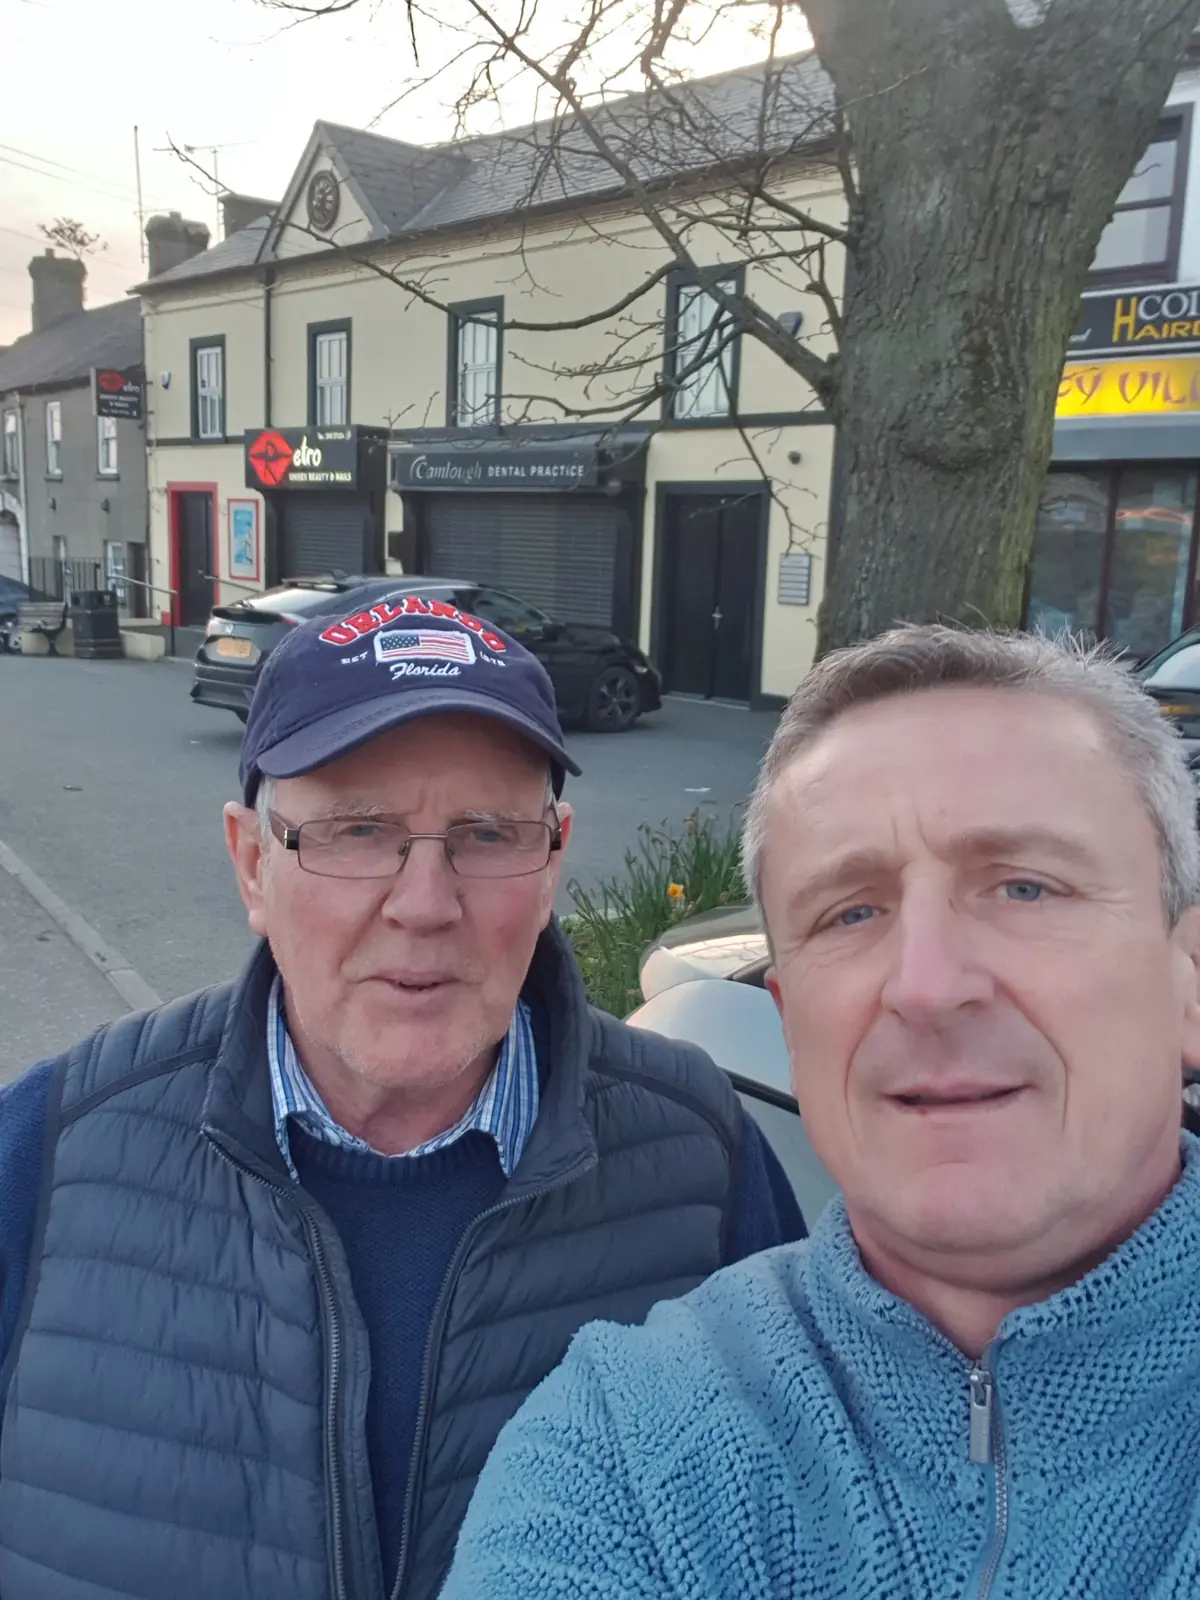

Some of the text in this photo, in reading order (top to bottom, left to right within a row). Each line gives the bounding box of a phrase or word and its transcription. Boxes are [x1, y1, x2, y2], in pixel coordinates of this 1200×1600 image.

[309, 472, 329, 481] BEAUTY
[336, 471, 352, 481] NAILS
[411, 455, 584, 484] Camlough DENTAL PRACTICE
[319, 596, 506, 652] ORLANDO
[340, 651, 368, 664] EST
[390, 662, 461, 680] Florida
